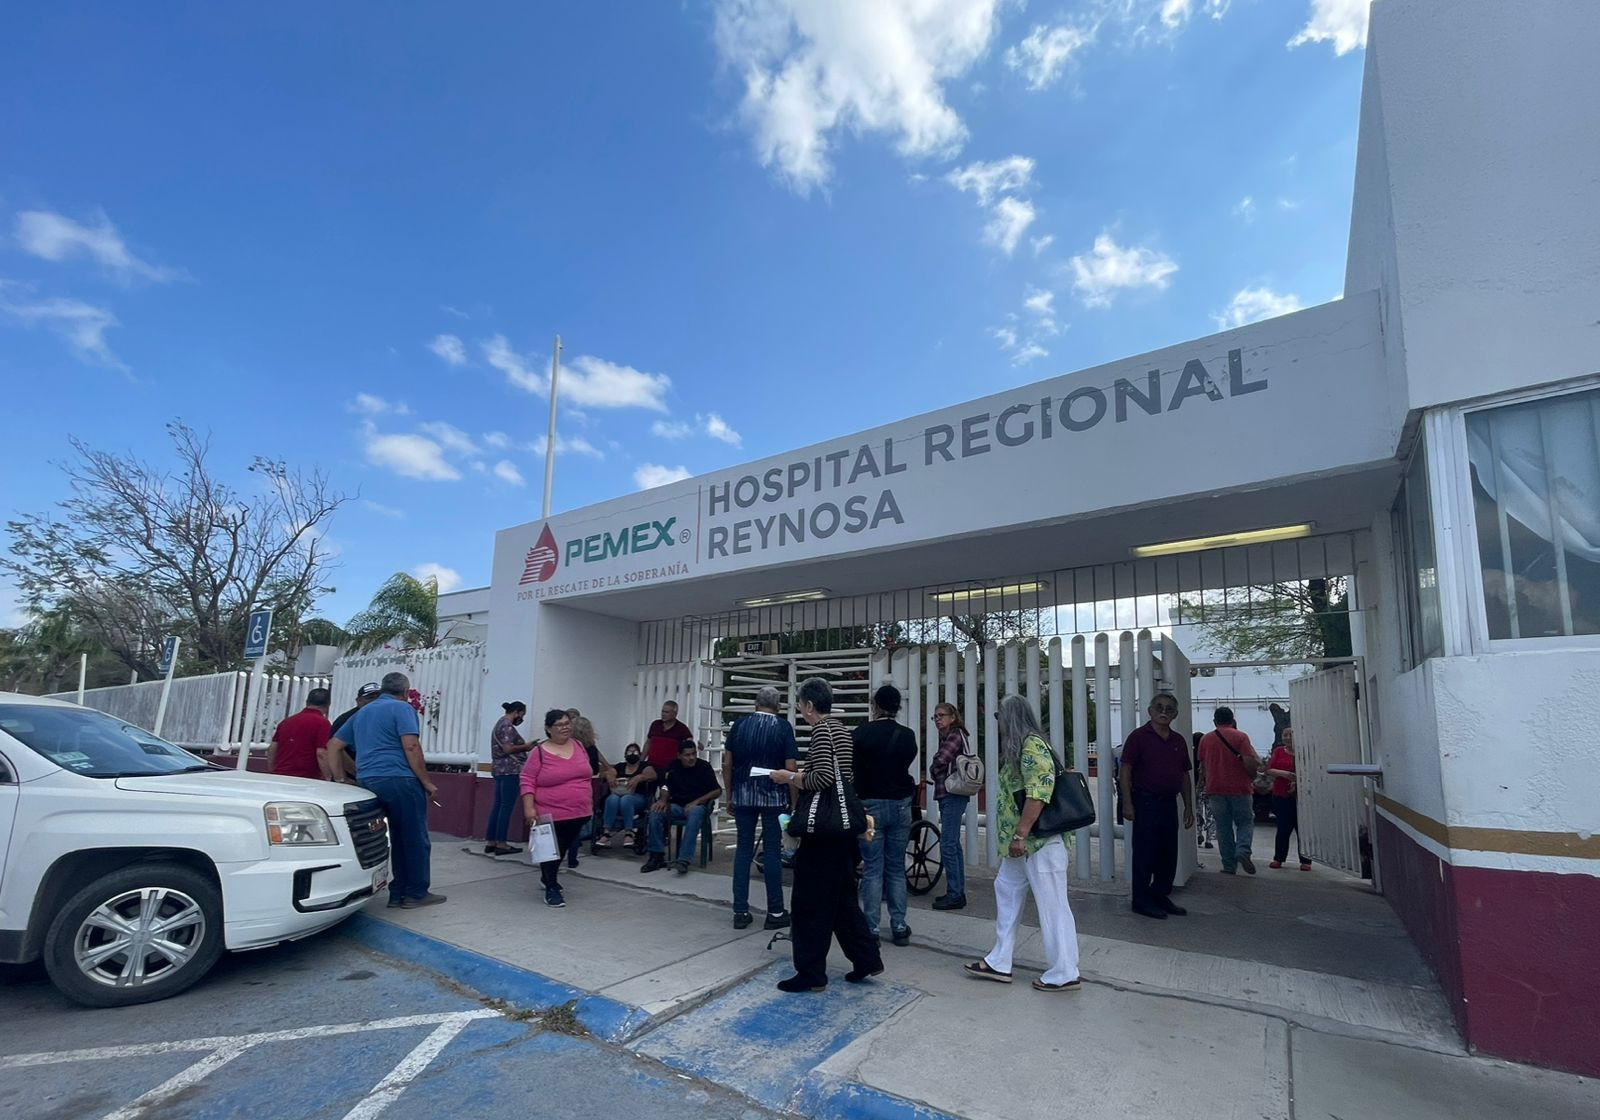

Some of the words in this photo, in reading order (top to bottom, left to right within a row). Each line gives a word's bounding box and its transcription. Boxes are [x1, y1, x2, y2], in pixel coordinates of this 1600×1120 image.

[709, 440, 906, 515] HOSPITAL
[924, 348, 1268, 466] REGIONAL
[566, 517, 676, 567] PEMEX
[709, 489, 904, 560] REYNOSA
[517, 590, 534, 602] POR
[535, 588, 546, 598] EL
[547, 580, 590, 597] RESCATE
[592, 578, 605, 589] DE
[607, 575, 621, 586] LA
[623, 561, 689, 584] SOBERANÍA
